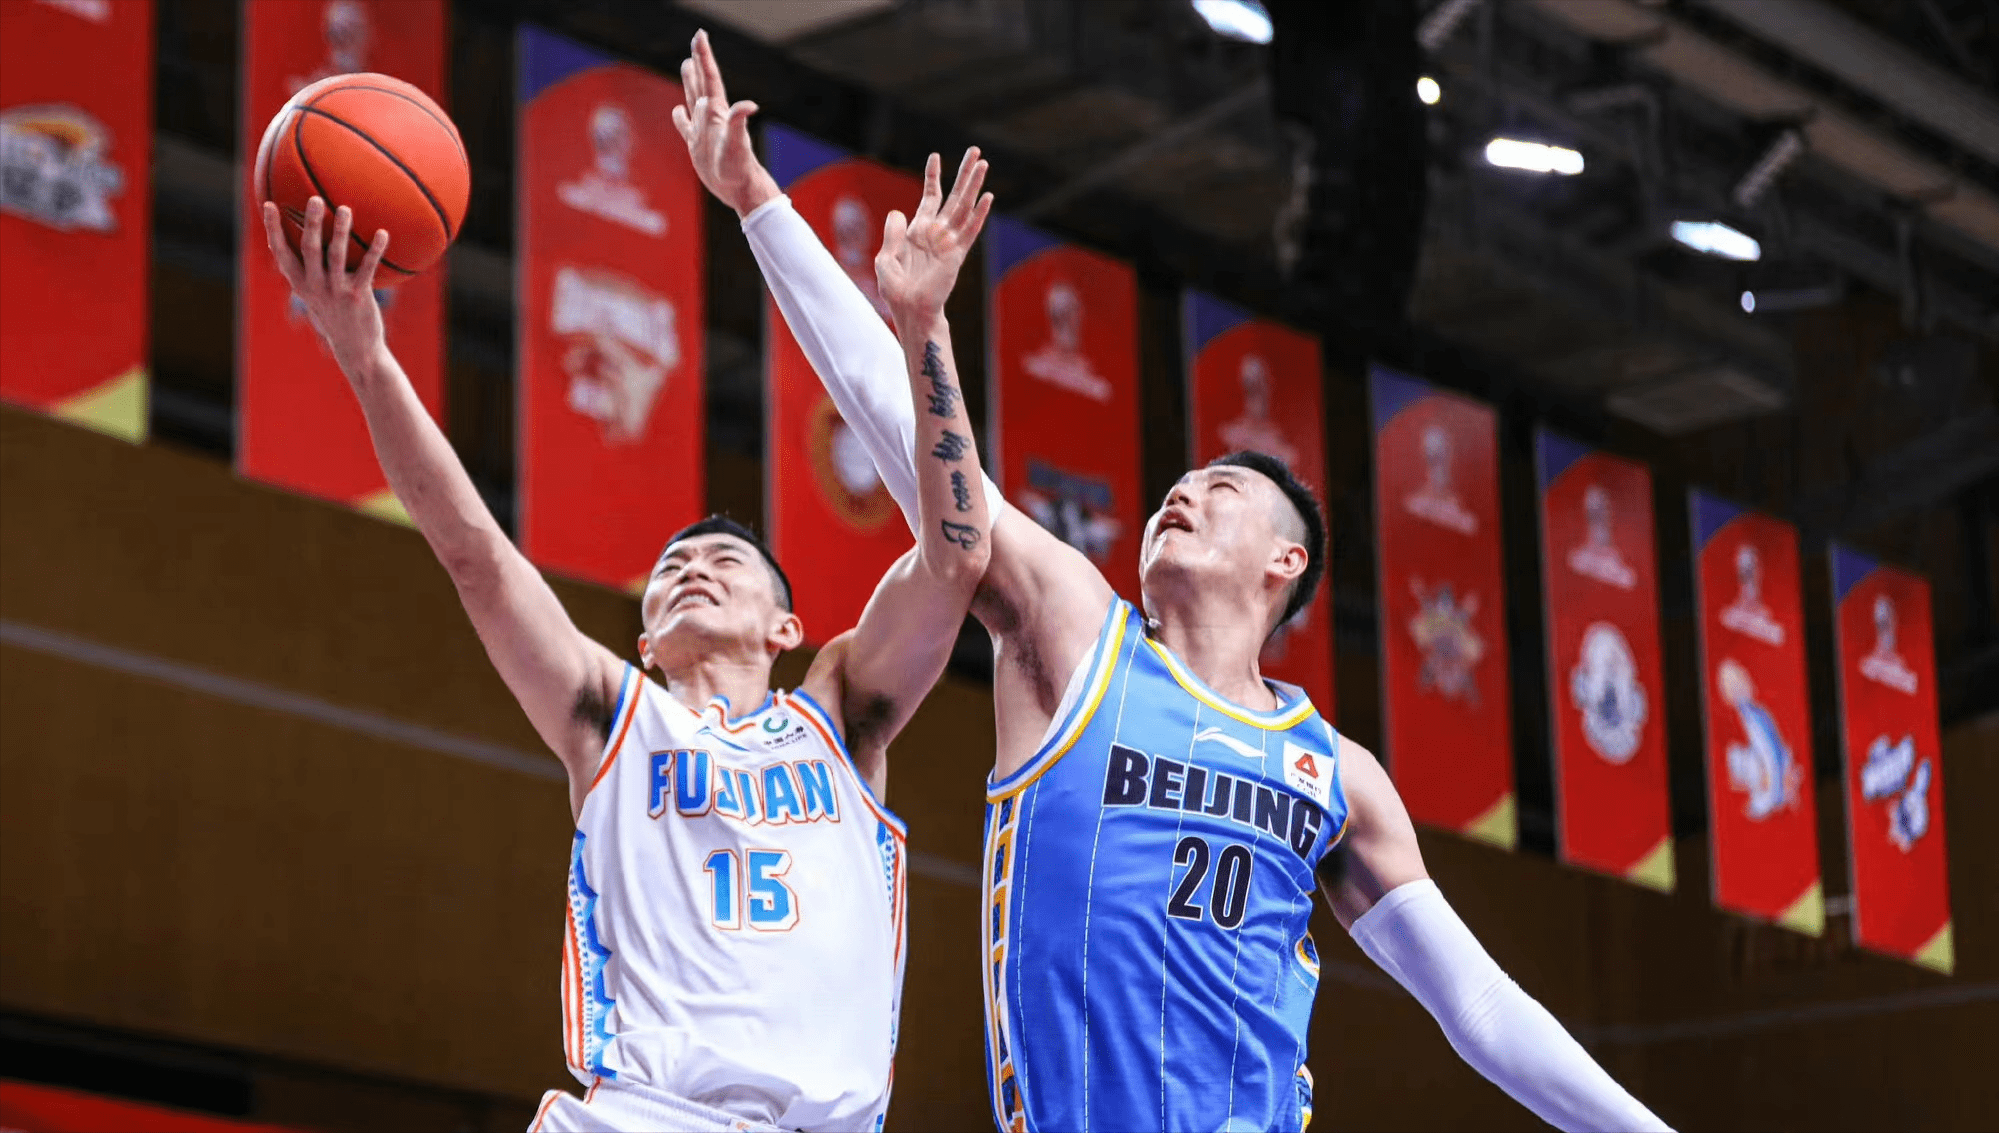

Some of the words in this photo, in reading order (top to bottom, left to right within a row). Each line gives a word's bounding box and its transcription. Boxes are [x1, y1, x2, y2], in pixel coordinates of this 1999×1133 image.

[647, 749, 841, 827] FUJIAN
[1101, 742, 1323, 860] BEIJING
[703, 848, 800, 932] 15
[1167, 836, 1253, 931] 20
